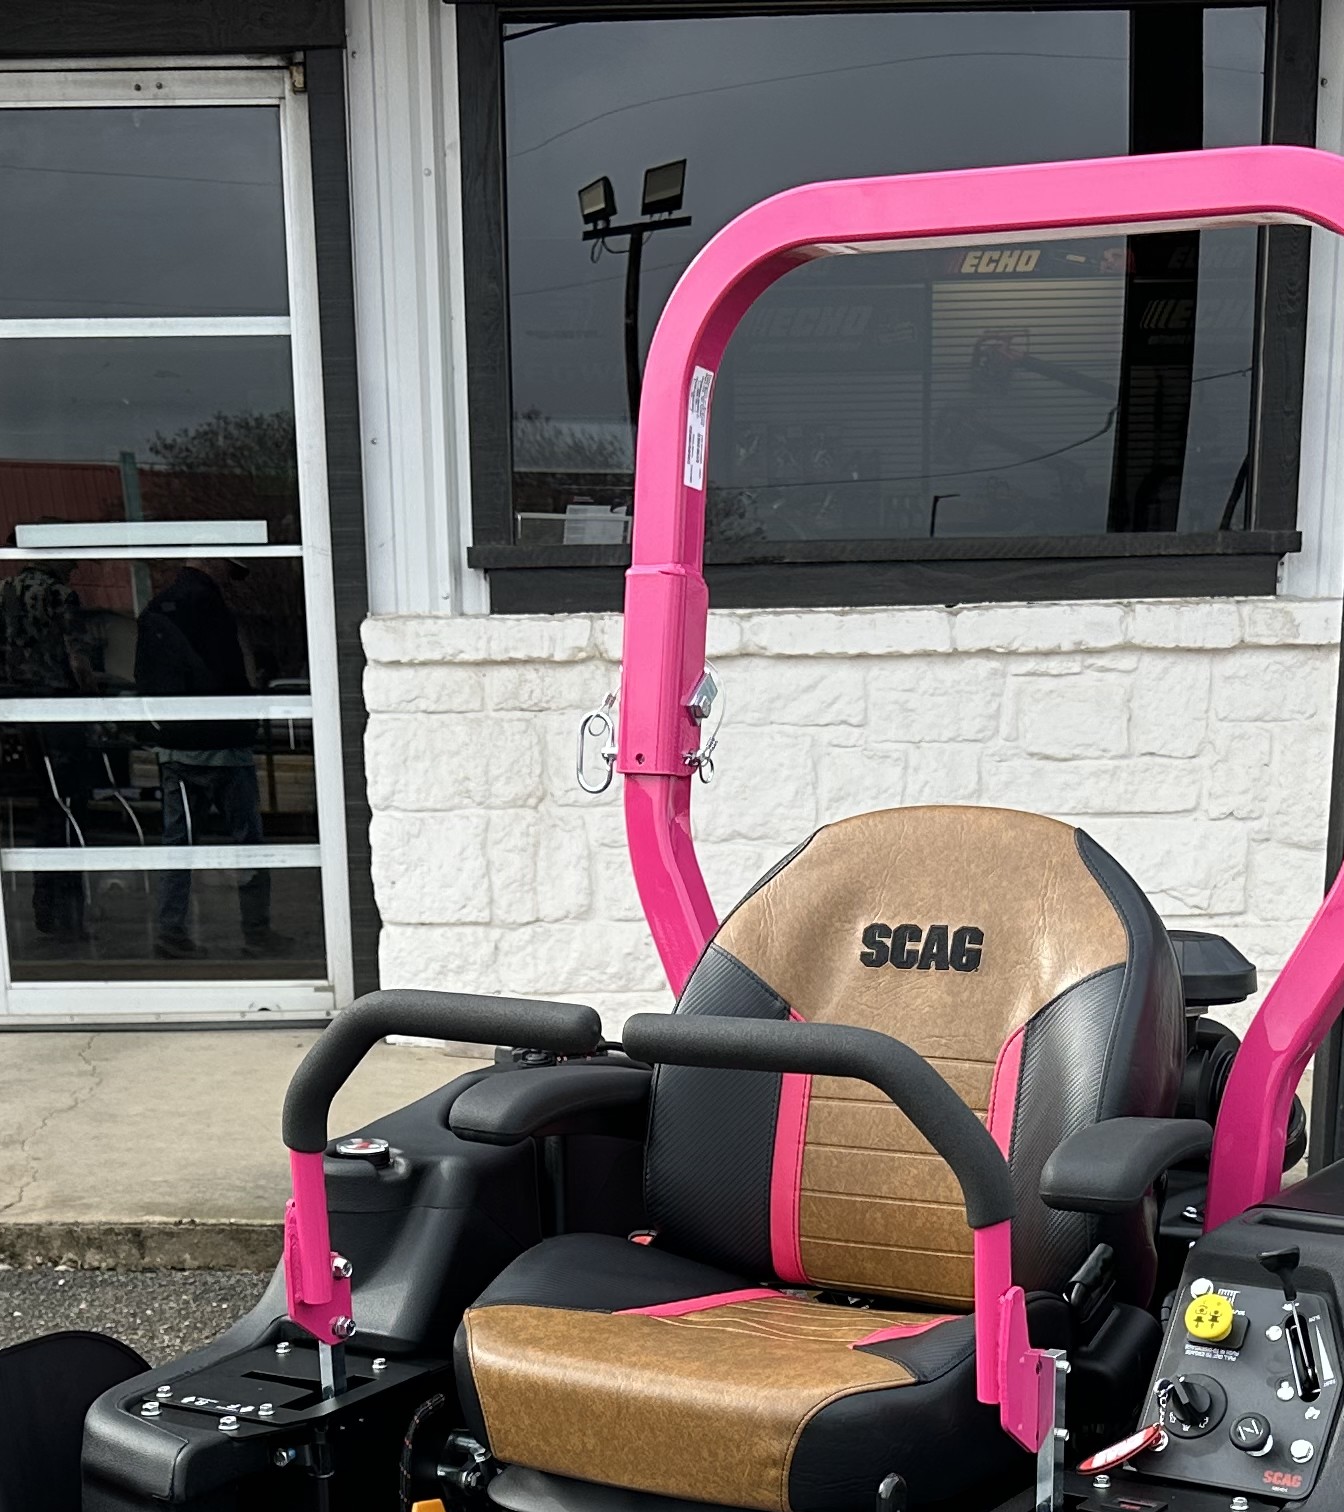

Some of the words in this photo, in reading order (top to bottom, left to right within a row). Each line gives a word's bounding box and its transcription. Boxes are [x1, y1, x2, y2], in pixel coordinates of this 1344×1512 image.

[961, 249, 1041, 274] ECHO
[860, 923, 984, 972] SCAG
[1263, 1469, 1304, 1488] SCAG
